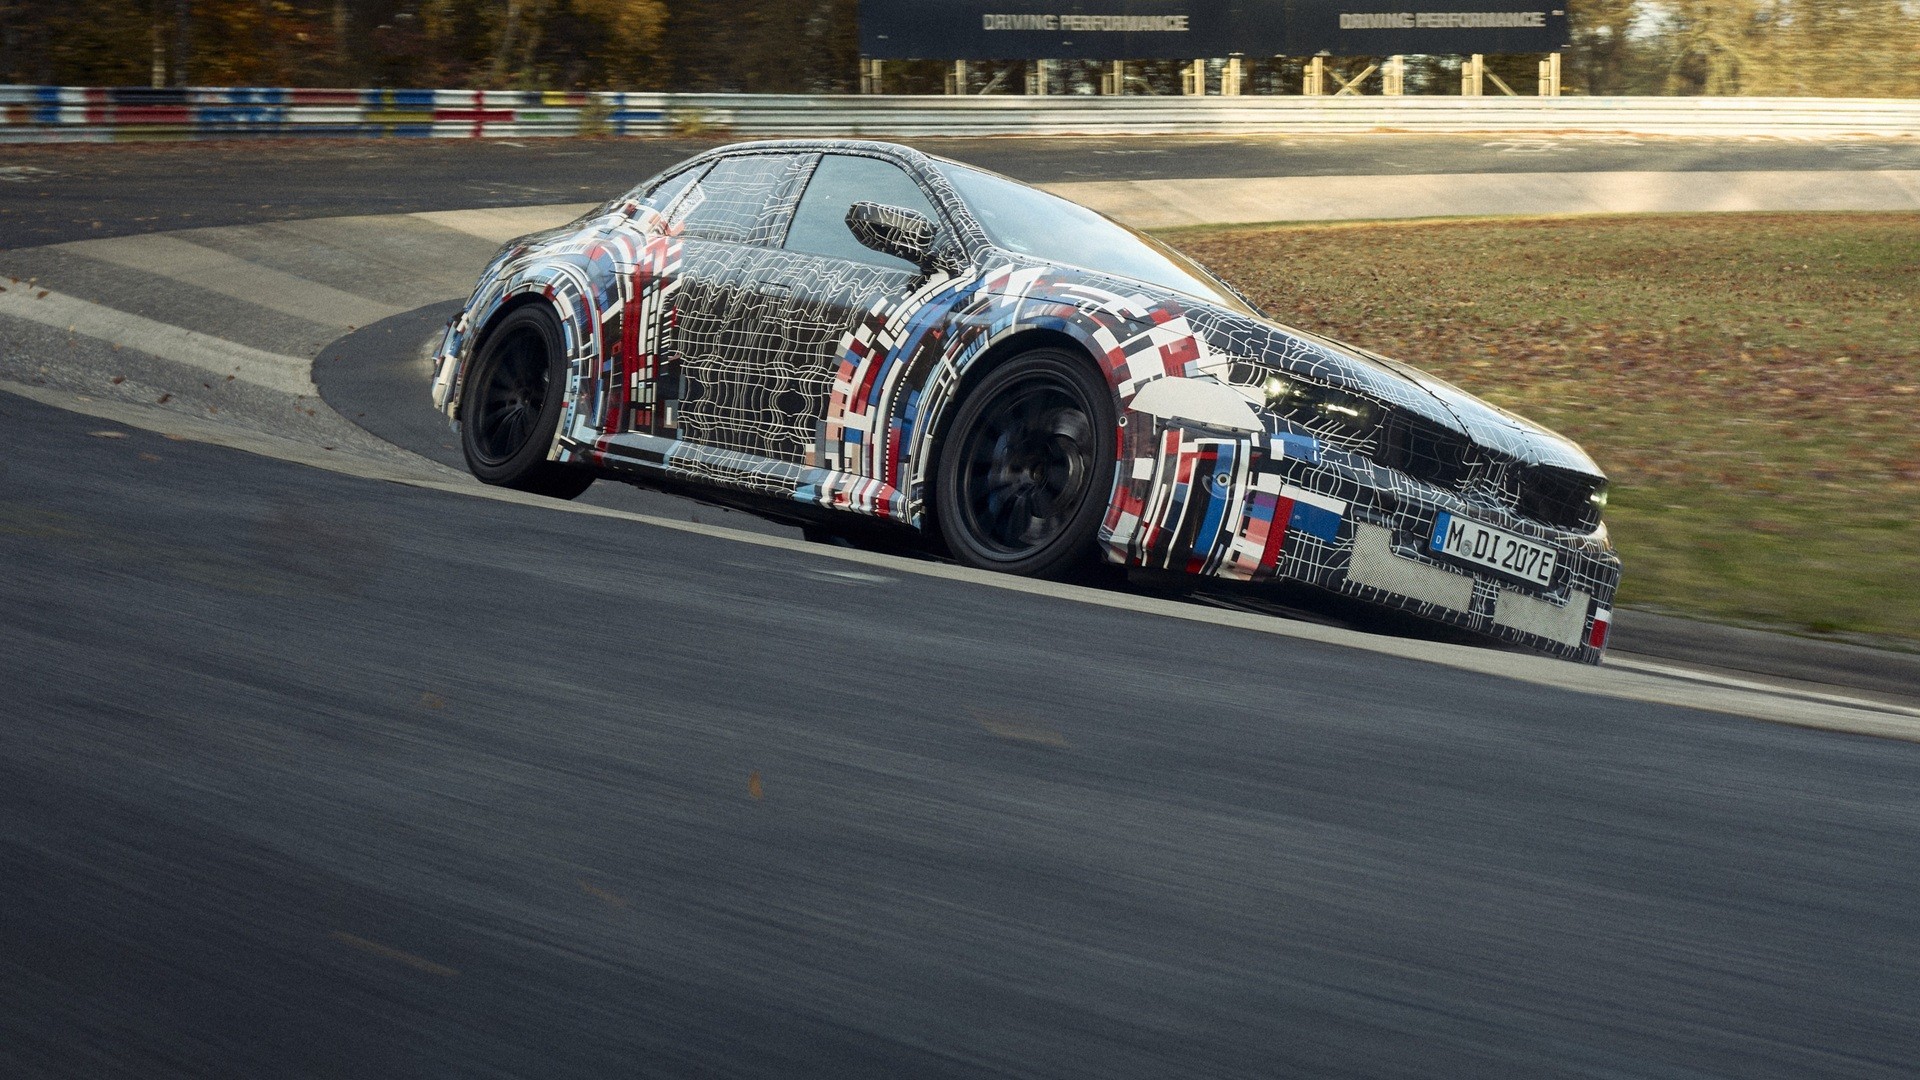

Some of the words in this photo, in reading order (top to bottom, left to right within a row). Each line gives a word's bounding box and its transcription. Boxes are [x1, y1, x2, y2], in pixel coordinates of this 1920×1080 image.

[983, 14, 1059, 30] DRIVING
[1060, 15, 1189, 31] PERFORMANCE
[1340, 12, 1415, 29] DRIVING
[1415, 12, 1546, 28] PERFORMANCE
[1435, 535, 1442, 544] D
[1447, 520, 1465, 552] M
[1472, 529, 1501, 564] DI
[1502, 540, 1554, 582] 207E
